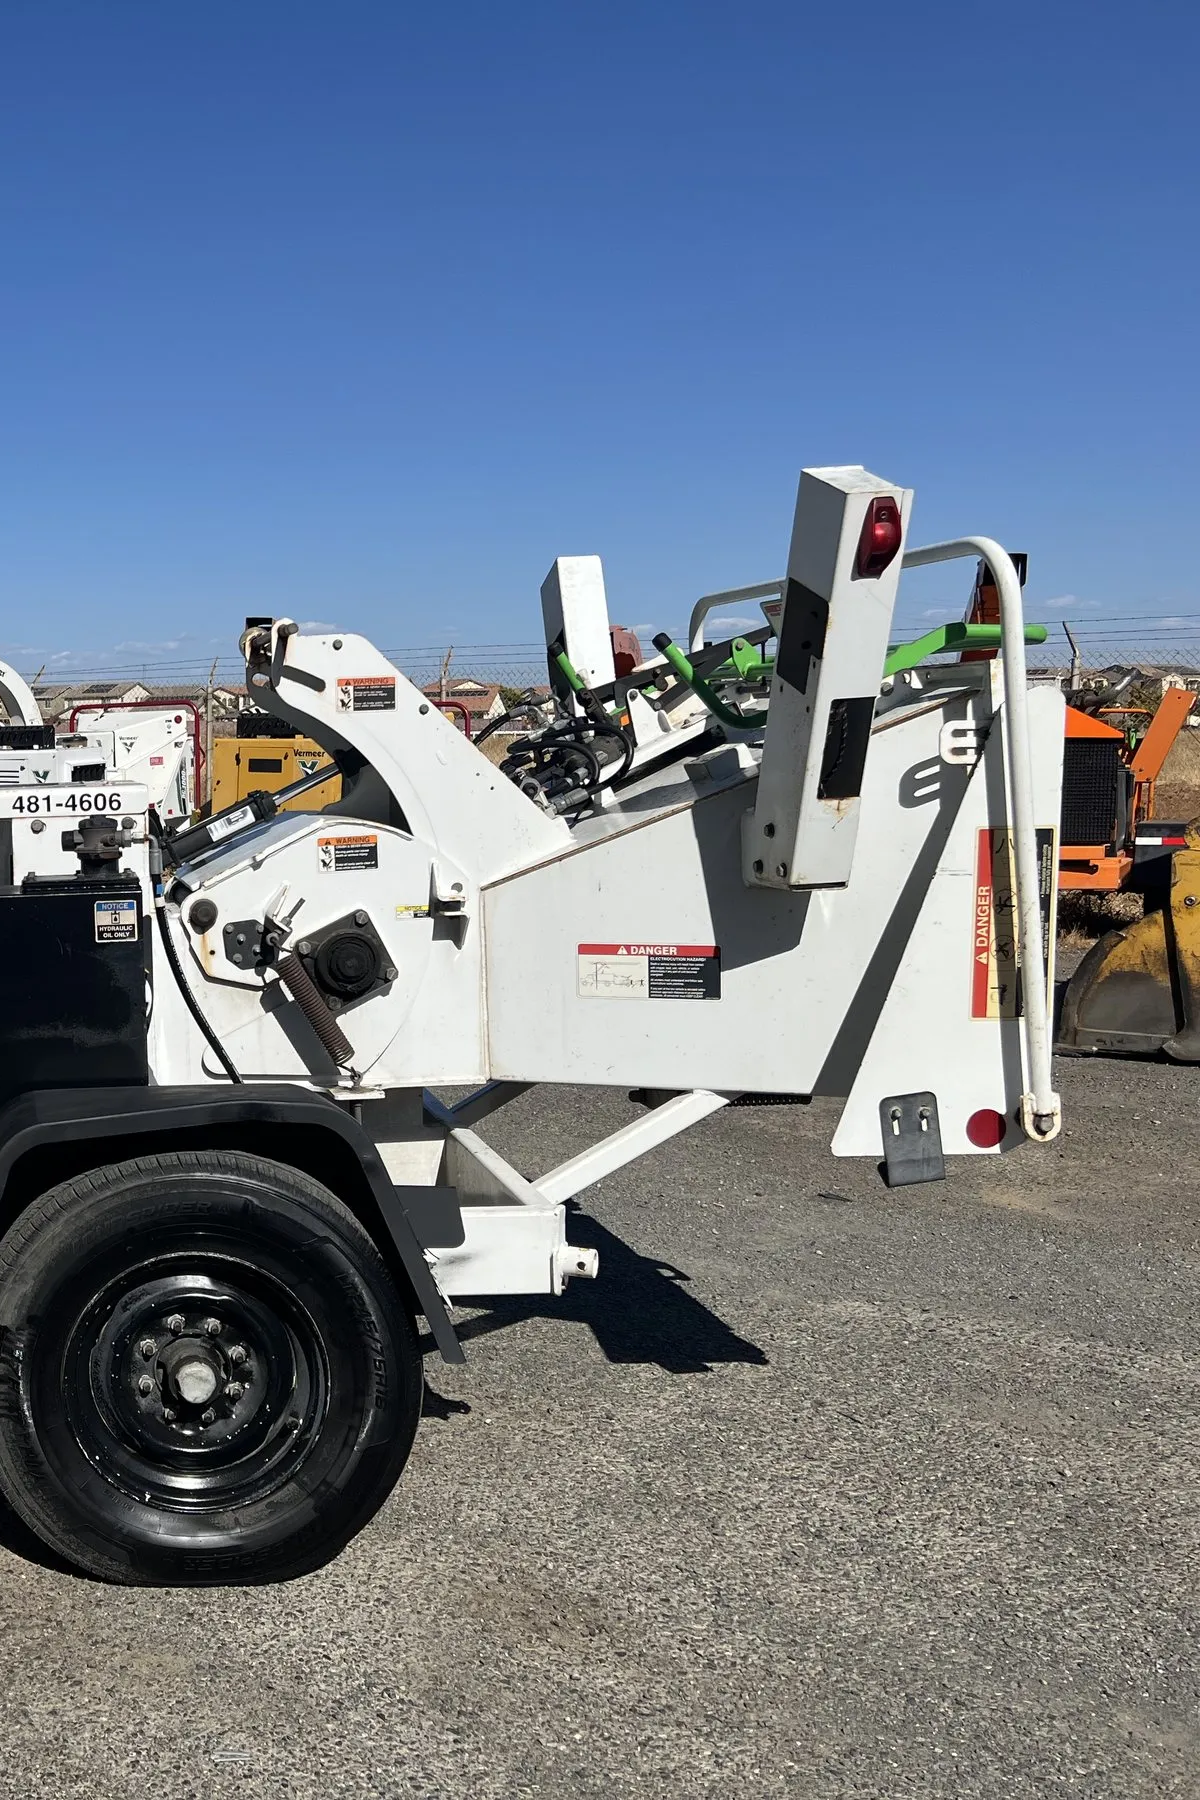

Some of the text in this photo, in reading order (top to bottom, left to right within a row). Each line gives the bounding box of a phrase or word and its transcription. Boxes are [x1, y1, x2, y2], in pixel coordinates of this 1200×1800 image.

[293, 748, 326, 758] Vermeer
[12, 793, 121, 813] 481-4606
[335, 836, 370, 844] WARNING
[976, 885, 991, 948] DANGER
[630, 946, 677, 955] DANGER
